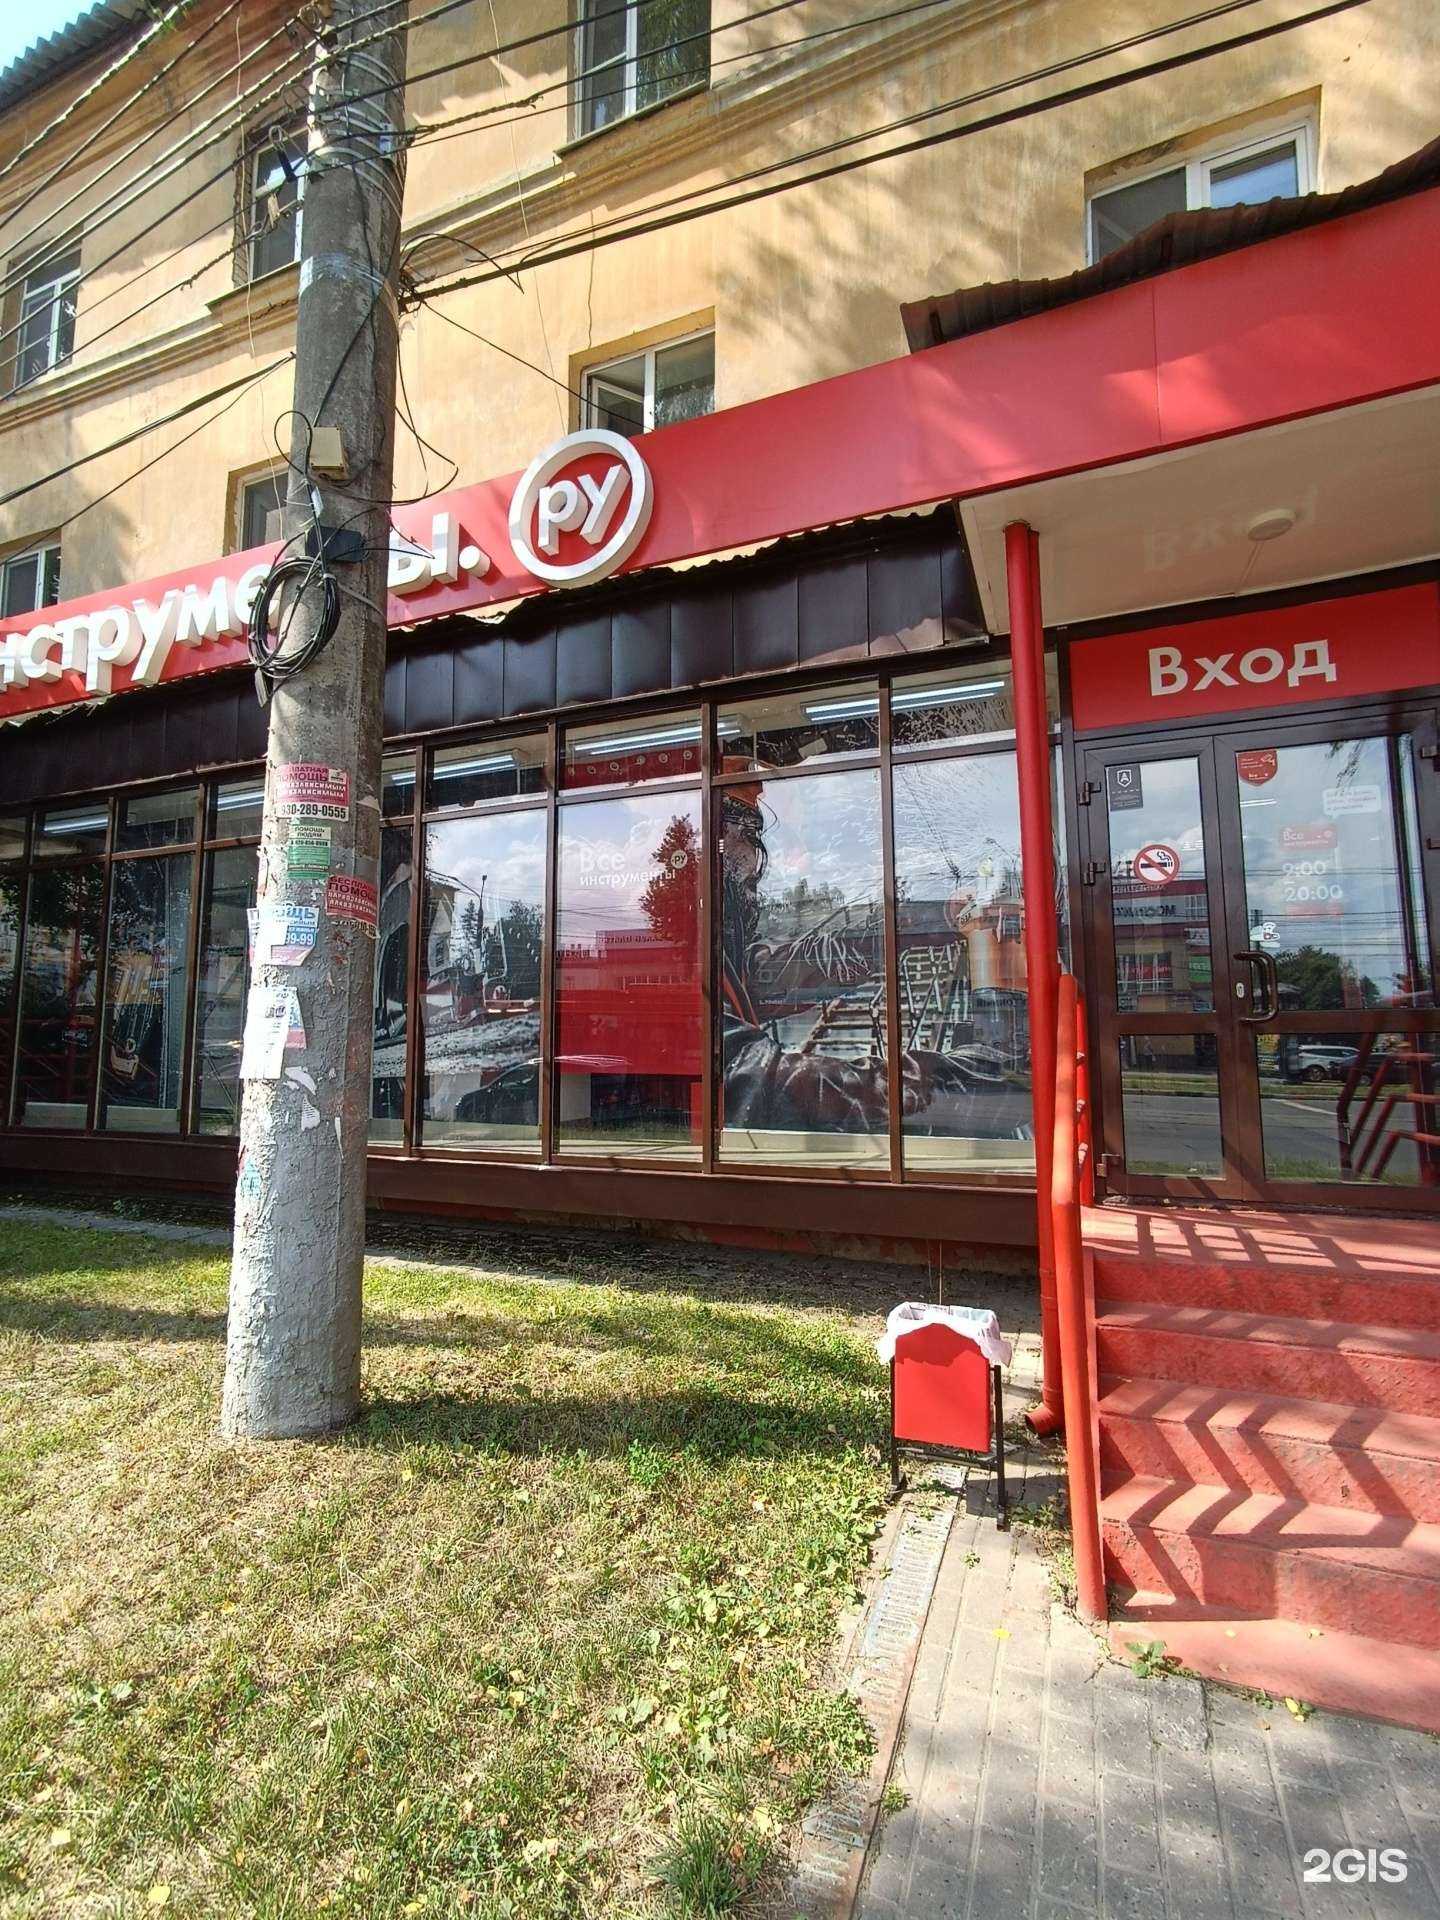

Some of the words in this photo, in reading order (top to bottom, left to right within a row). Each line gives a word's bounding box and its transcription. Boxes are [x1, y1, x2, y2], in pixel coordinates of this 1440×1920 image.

[1148, 639, 1338, 696] Вход
[579, 846, 625, 872] Все
[580, 868, 676, 888] инструменты
[1284, 885, 1343, 902] 20:00
